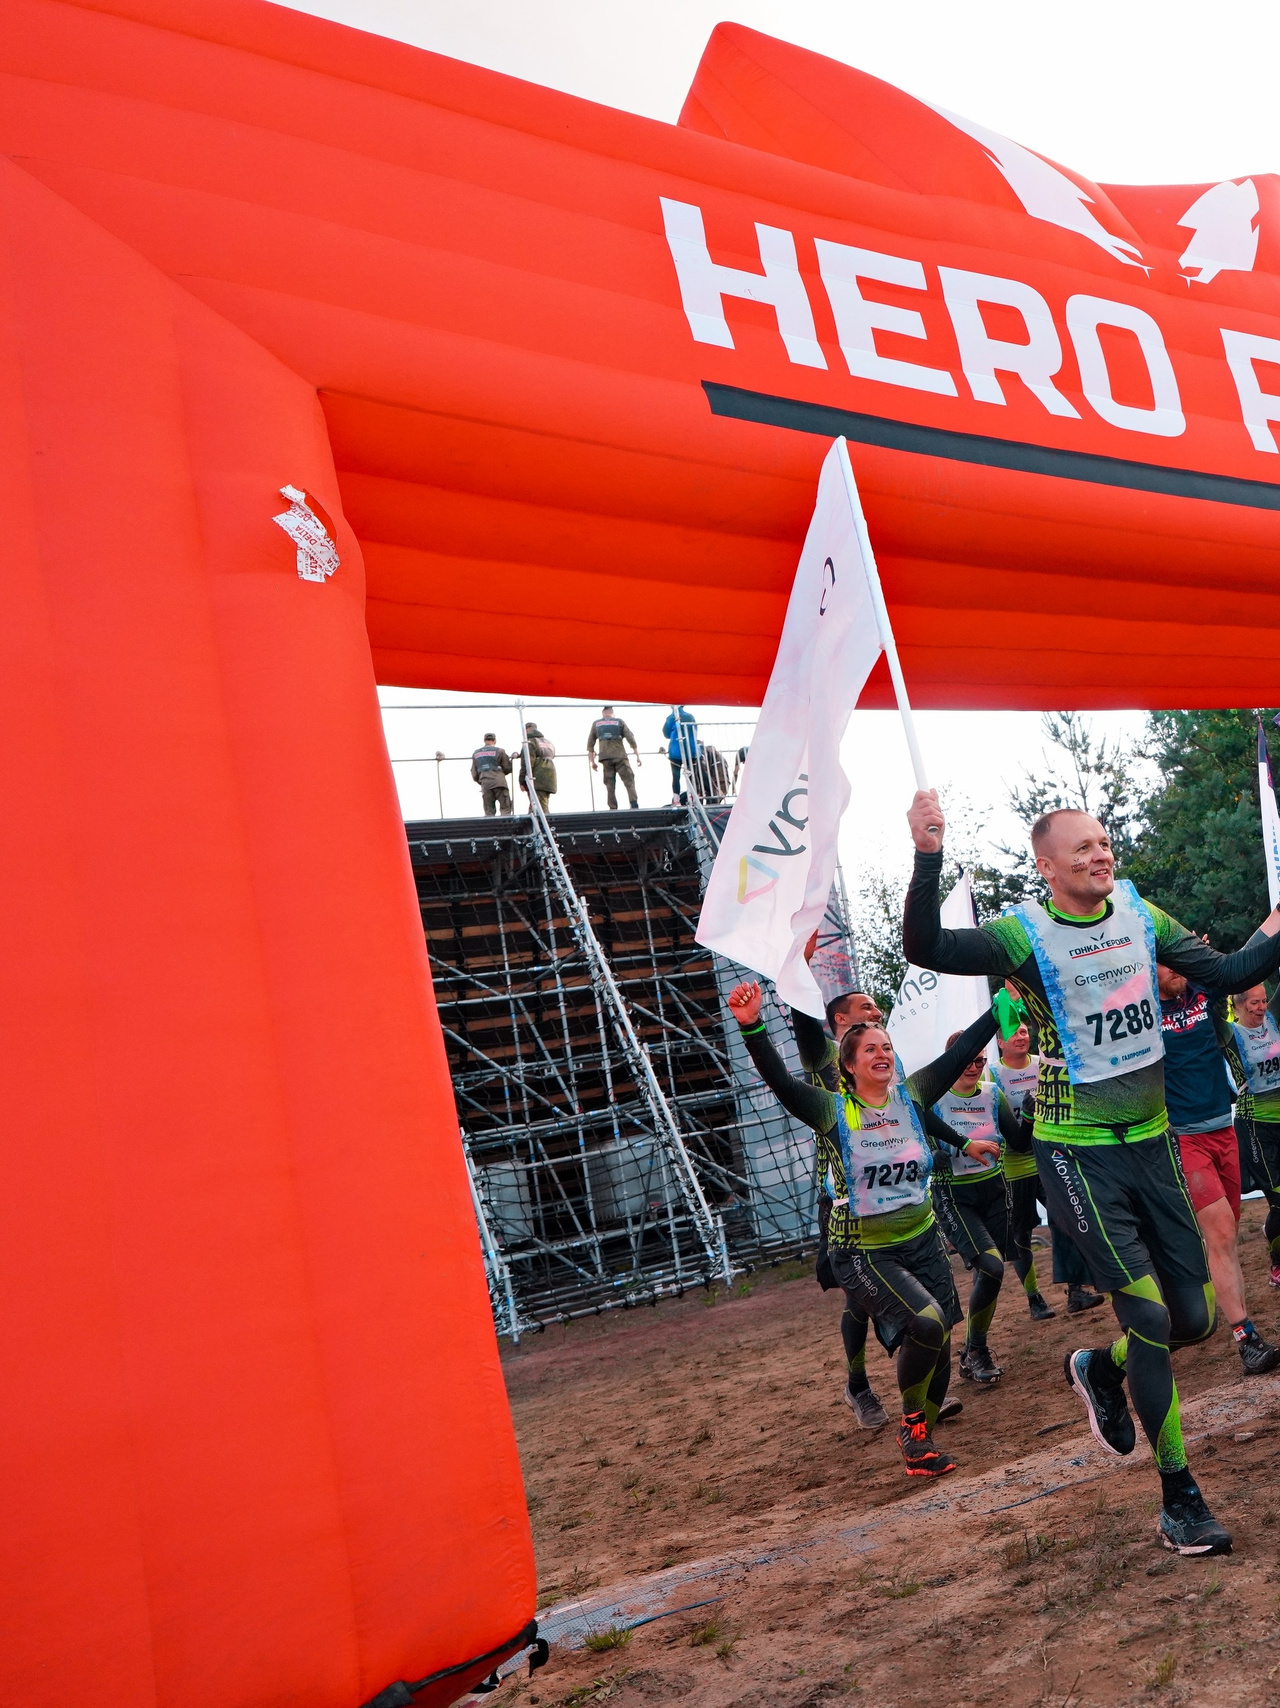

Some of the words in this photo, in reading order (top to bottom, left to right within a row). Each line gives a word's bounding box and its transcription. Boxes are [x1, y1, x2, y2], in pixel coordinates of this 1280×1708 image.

[659, 196, 1186, 438] HERO
[295, 525, 318, 546] DELTA
[1069, 944, 1100, 957] ГОНКА
[1101, 936, 1131, 949] ГЕРОЕВ
[1074, 963, 1138, 987] Greenway
[1085, 999, 1154, 1046] 7288
[864, 1160, 918, 1190] 7273
[1053, 1159, 1089, 1233] Greenway
